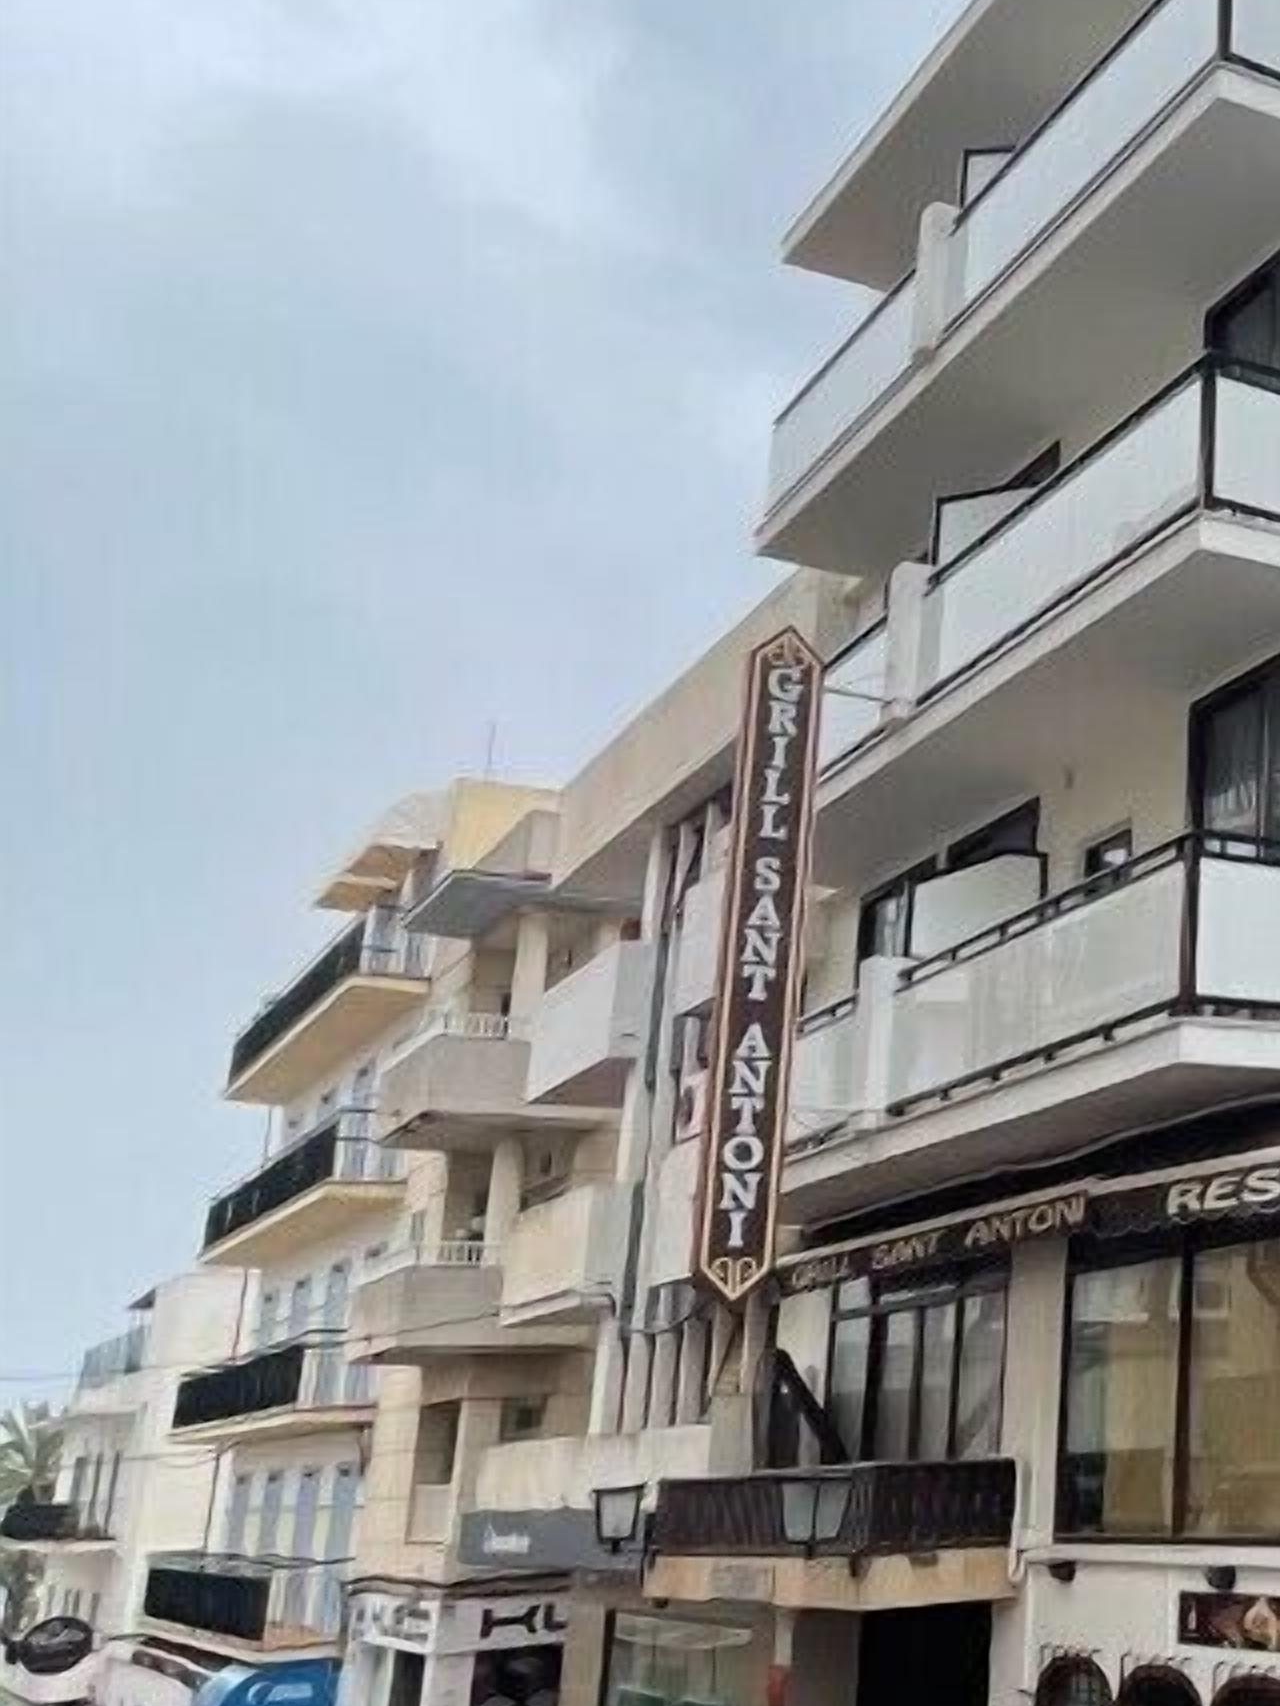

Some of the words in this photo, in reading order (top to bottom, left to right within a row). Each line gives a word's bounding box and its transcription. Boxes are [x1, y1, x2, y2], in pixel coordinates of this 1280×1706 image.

[760, 666, 803, 839] GRILL
[740, 856, 783, 1002] SANT
[721, 1022, 773, 1248] ANTONI
[964, 1189, 1089, 1247] ANTONI
